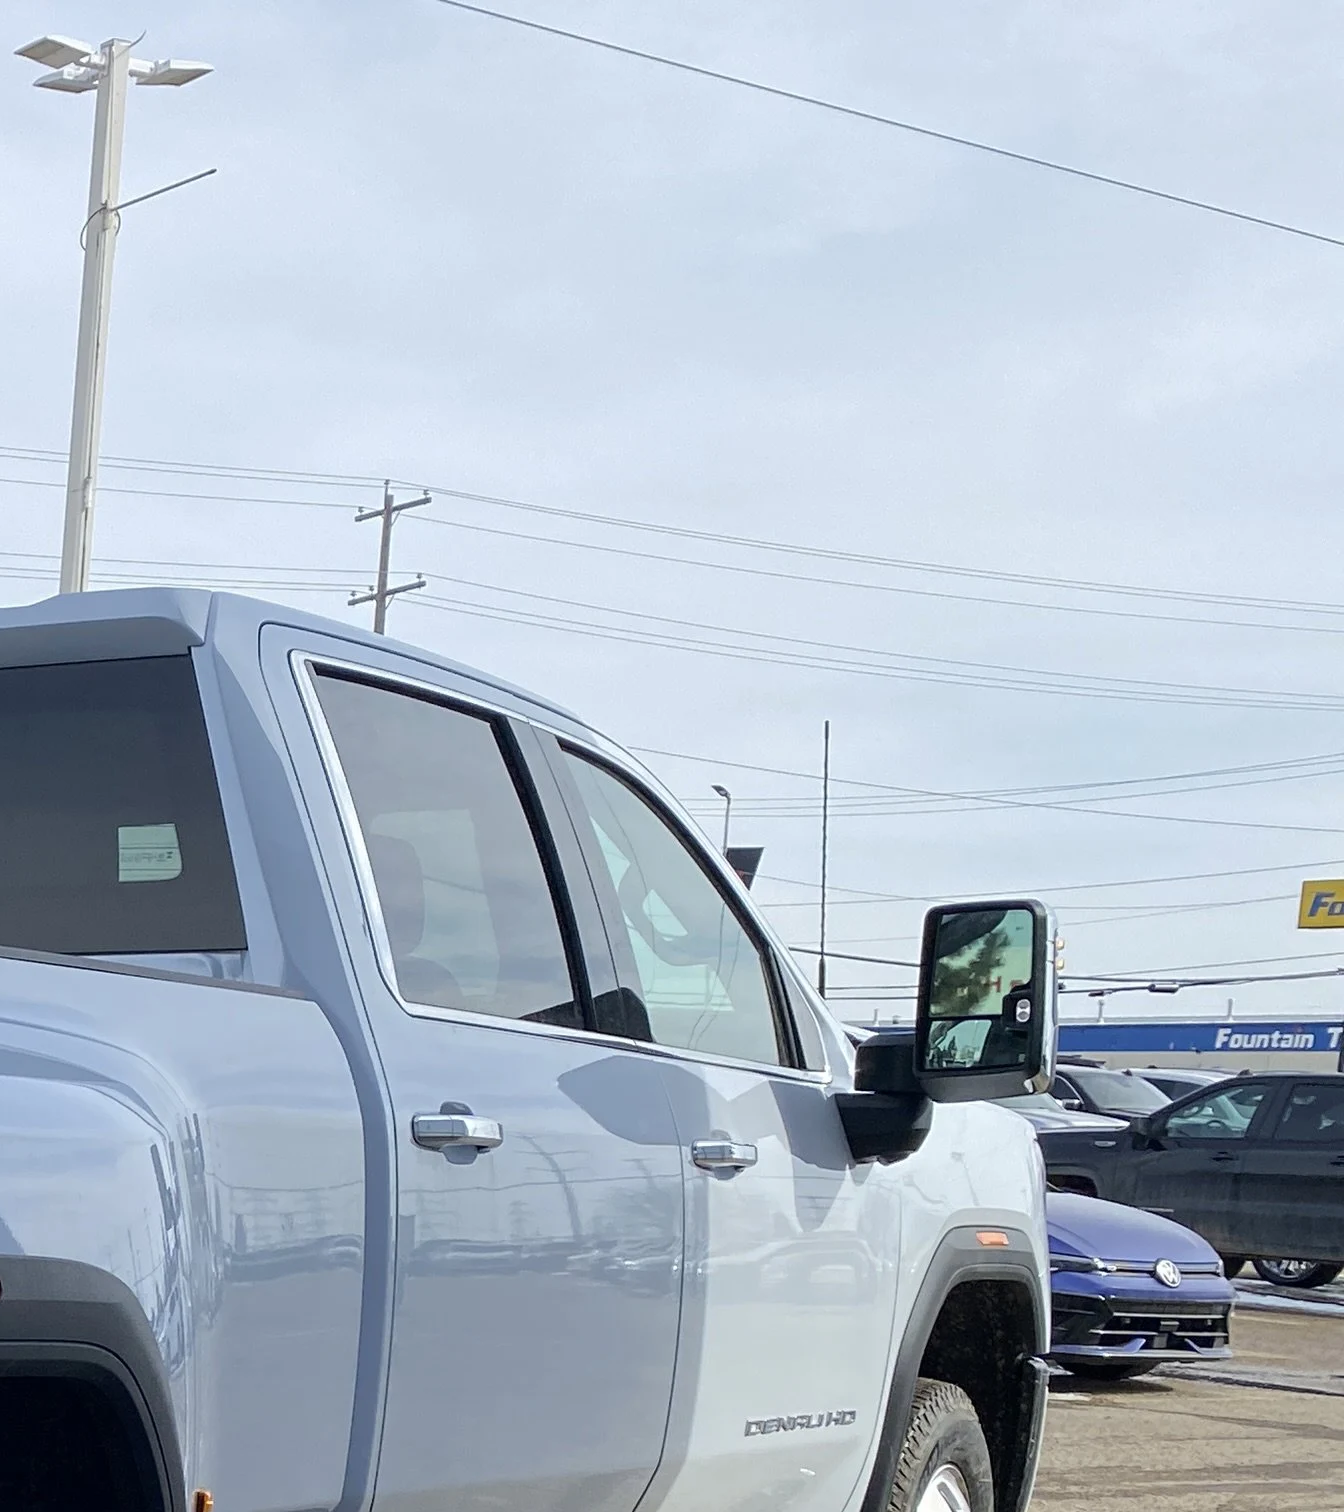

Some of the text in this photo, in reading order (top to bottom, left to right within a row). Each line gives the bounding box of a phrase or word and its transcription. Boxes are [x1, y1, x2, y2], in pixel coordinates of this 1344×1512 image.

[1215, 1028, 1314, 1048] Fountain
[744, 1410, 857, 1437] DENALI HD
